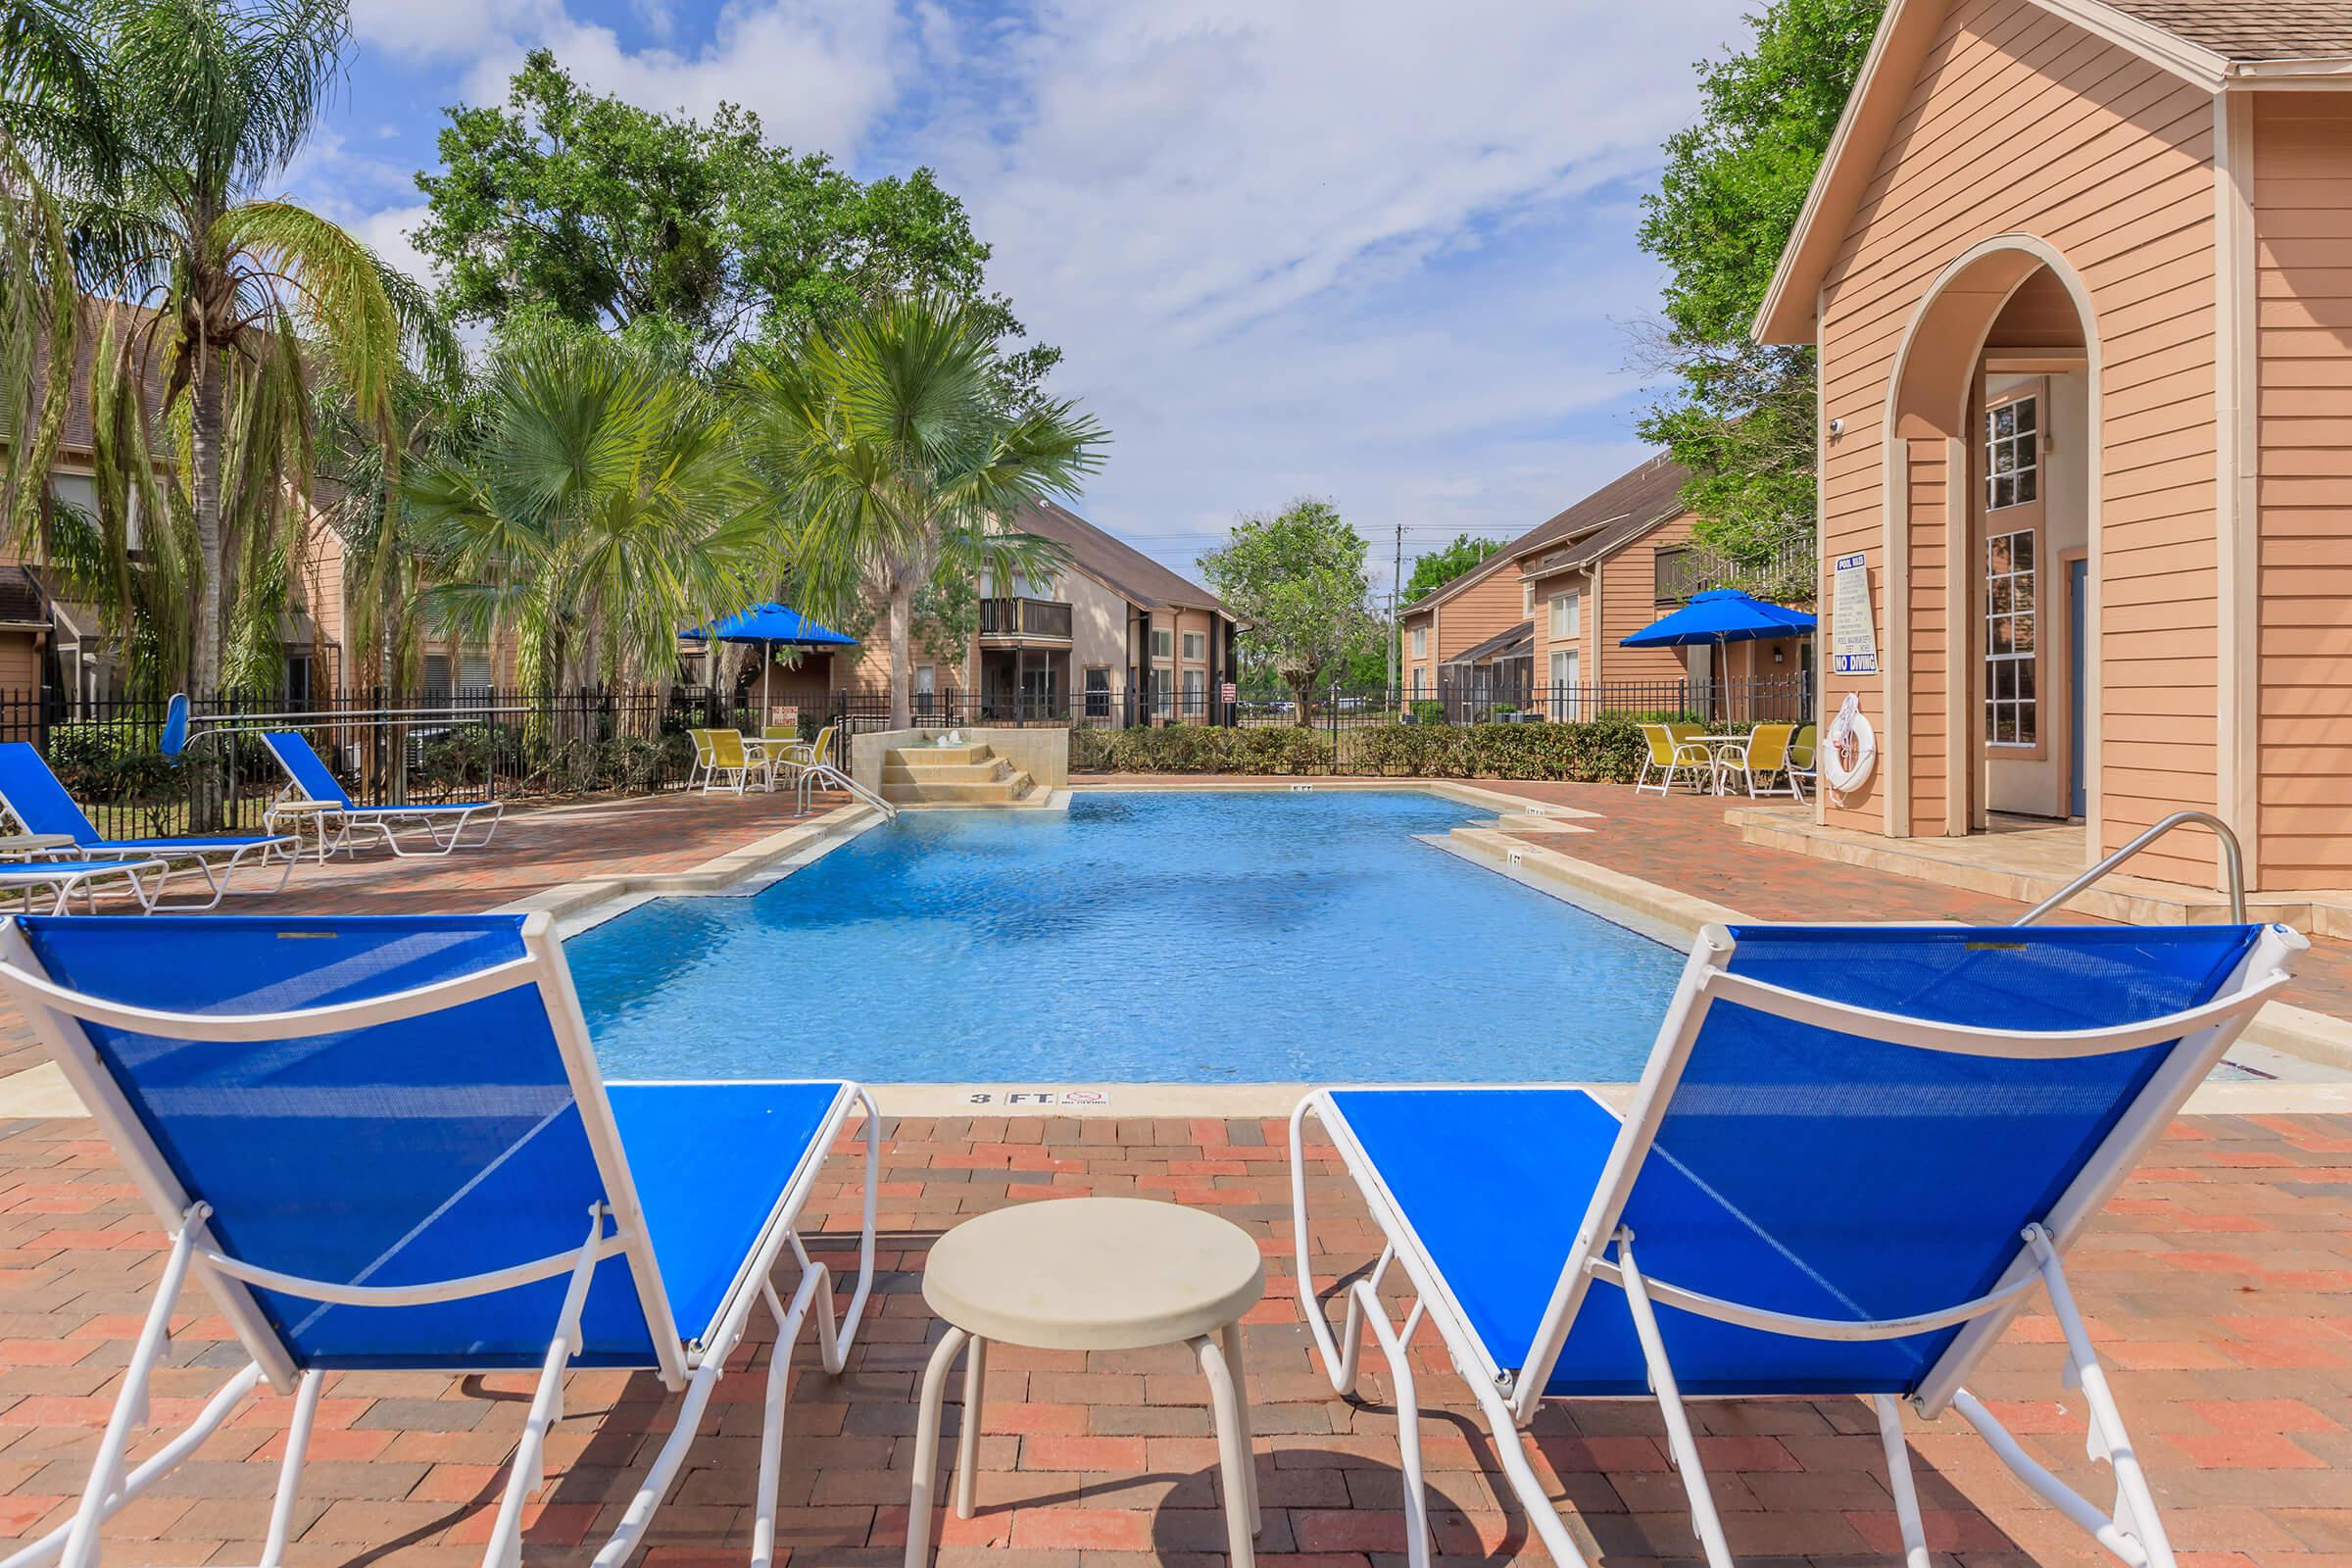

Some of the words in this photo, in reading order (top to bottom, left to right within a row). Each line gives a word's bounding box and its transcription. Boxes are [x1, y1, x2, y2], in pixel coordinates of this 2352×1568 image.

[1838, 559, 1852, 570] POOL
[1836, 656, 1847, 671] NO
[1850, 655, 1876, 671] DIVING
[969, 1093, 992, 1103] 3
